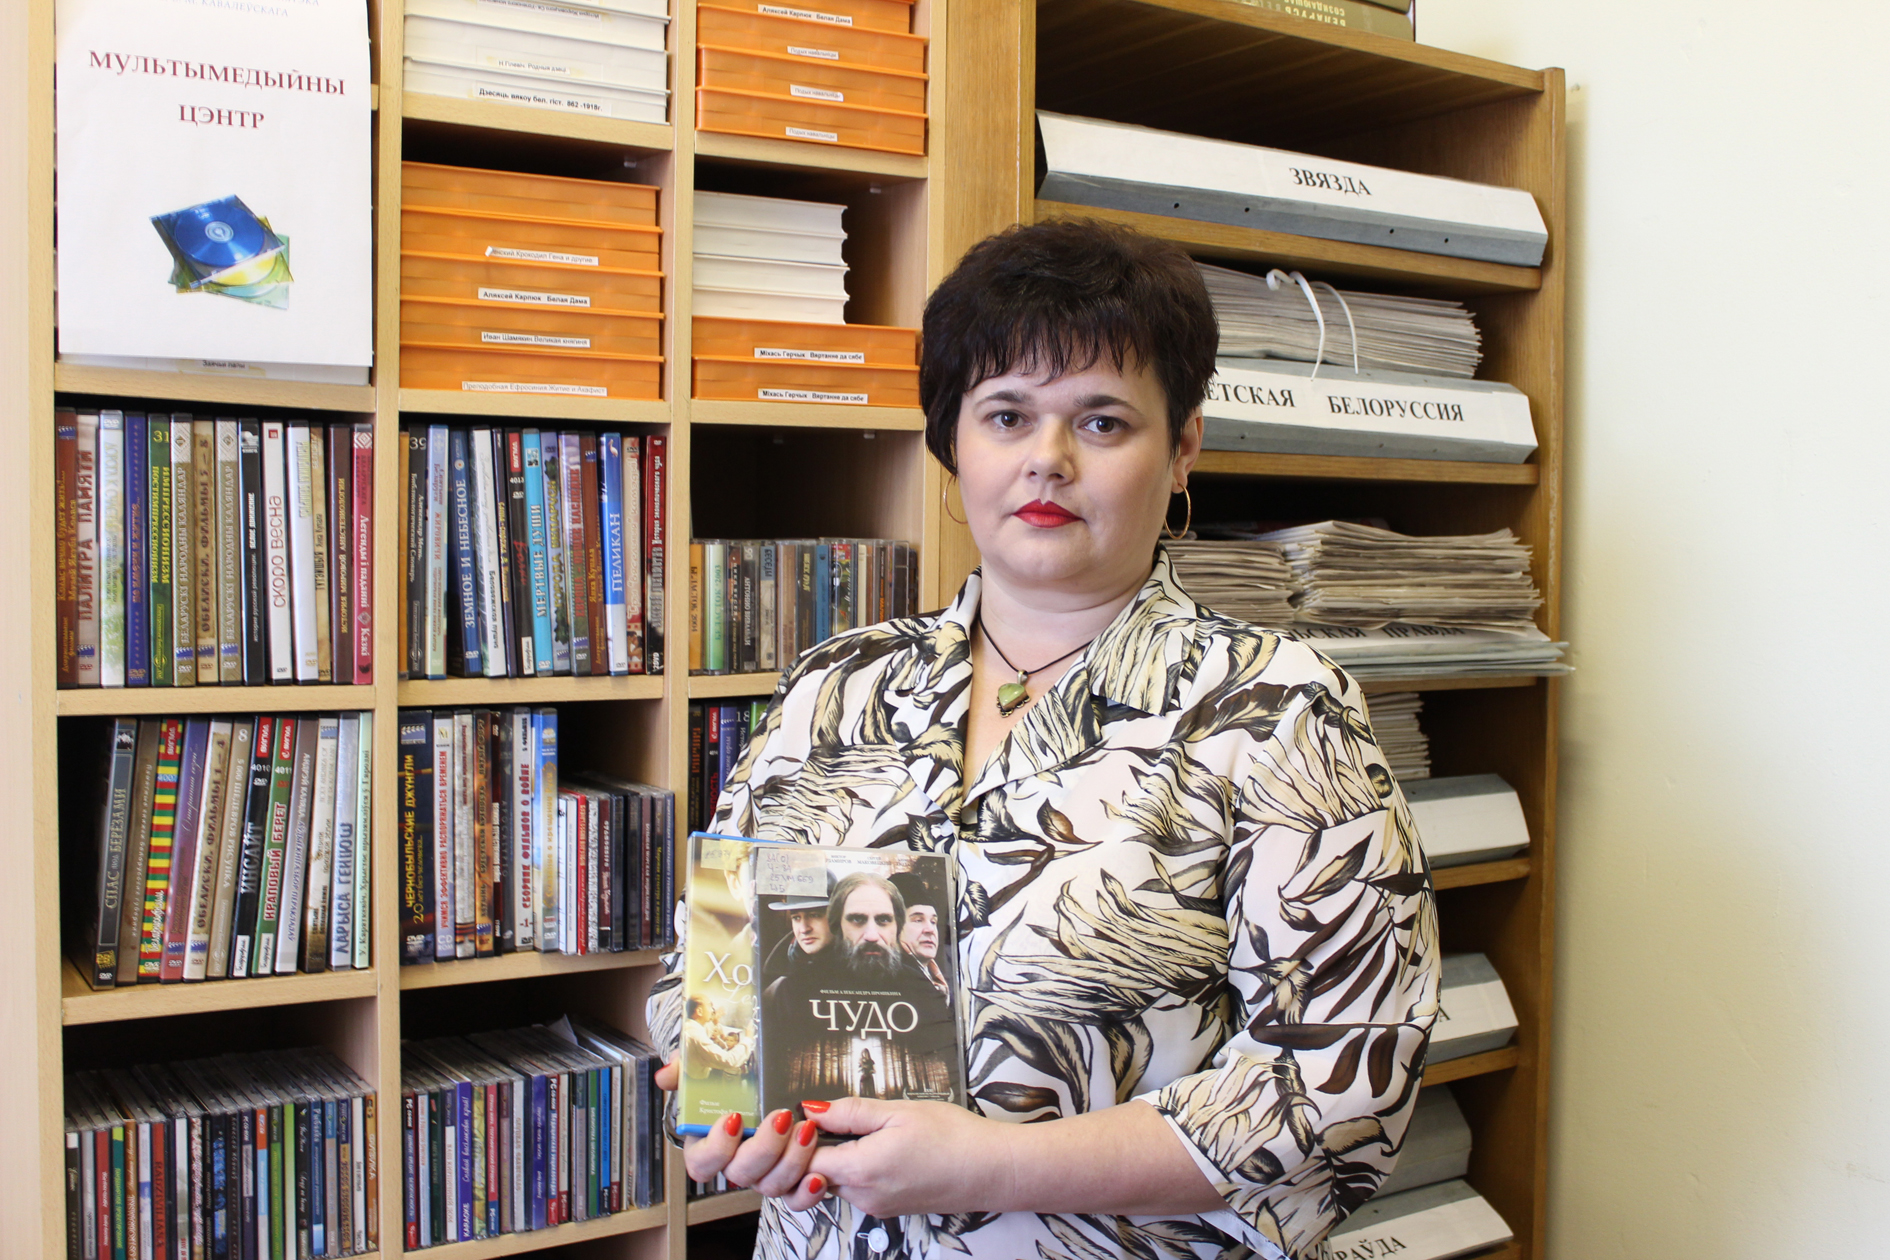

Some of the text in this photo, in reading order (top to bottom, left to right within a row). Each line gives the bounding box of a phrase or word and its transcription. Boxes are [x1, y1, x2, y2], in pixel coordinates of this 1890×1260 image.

[88, 48, 346, 96] МУЛЬТЫМЕДЫЙНЫ
[567, 100, 578, 108] 862
[178, 104, 265, 129] ЦЭНТР
[1289, 166, 1372, 197] ЗВЯЗДА
[516, 250, 547, 259] Крокодил
[549, 253, 564, 261] Гена
[483, 291, 513, 299] Аляксей
[514, 293, 541, 301] Карпюк
[570, 297, 587, 305] Дама
[1328, 395, 1464, 422] БЕЛОРУССИЯ
[77, 450, 93, 621] ПАЛИТРА ПАМЯТИ
[151, 466, 160, 583] ПОСТИМПРЕССИОНИЗМ
[162, 466, 170, 583] ИМПРЕССИОНИЗМ
[199, 481, 210, 548] ФИЛЬМЫ
[434, 511, 442, 560] ЖИРОВИЧИ
[546, 480, 564, 608] ГОРОДА БЕЛАРУСИ
[177, 467, 190, 643] БЕЛАРУСКІ НАРОДНЫ КАЛЯНДАР
[224, 465, 236, 639] БЕЛАРУСКІ НАРОДНЫ КАЛЯНДАР
[338, 477, 348, 633] ИСТОРИЯ МИРОВОЙ АНЕСТЕЗИОЛОГИИ
[359, 514, 370, 656] Легенды паданні Казкі
[456, 479, 476, 629] ЗЕМНОЕ И НЕБЕСНОЕ
[530, 504, 547, 617] МЕРТВЫЕ ДУШИ
[609, 513, 623, 592] ПЕЛИКАН
[764, 549, 773, 577] БЕСЕДЫ
[519, 763, 530, 795] ВОЙНЕ
[206, 780, 222, 845] ФИЛЬМЫ
[403, 754, 416, 908] ЧЕРНОБЫЛЬСКИЕ ДЖУНГЛИ
[438, 750, 448, 929] УЧИМСЯ ЭФФЕКТИВНО РАСПОРЯЖАТЬСЯ ВРЕМЕНЕМ
[520, 811, 530, 859] ФИЛЬМОВ
[104, 788, 127, 909] СПАС БЕРЁЗАМИ
[241, 822, 263, 894] ИНСАЙТ
[264, 801, 287, 921] КРАПОВЫЙ БЕРЕТ
[413, 903, 424, 923] 20
[521, 864, 531, 909] СБОРНИК
[336, 892, 351, 954] ЛАРЫСА
[438, 935, 453, 944] CD
[809, 999, 919, 1040] ЧУДО
